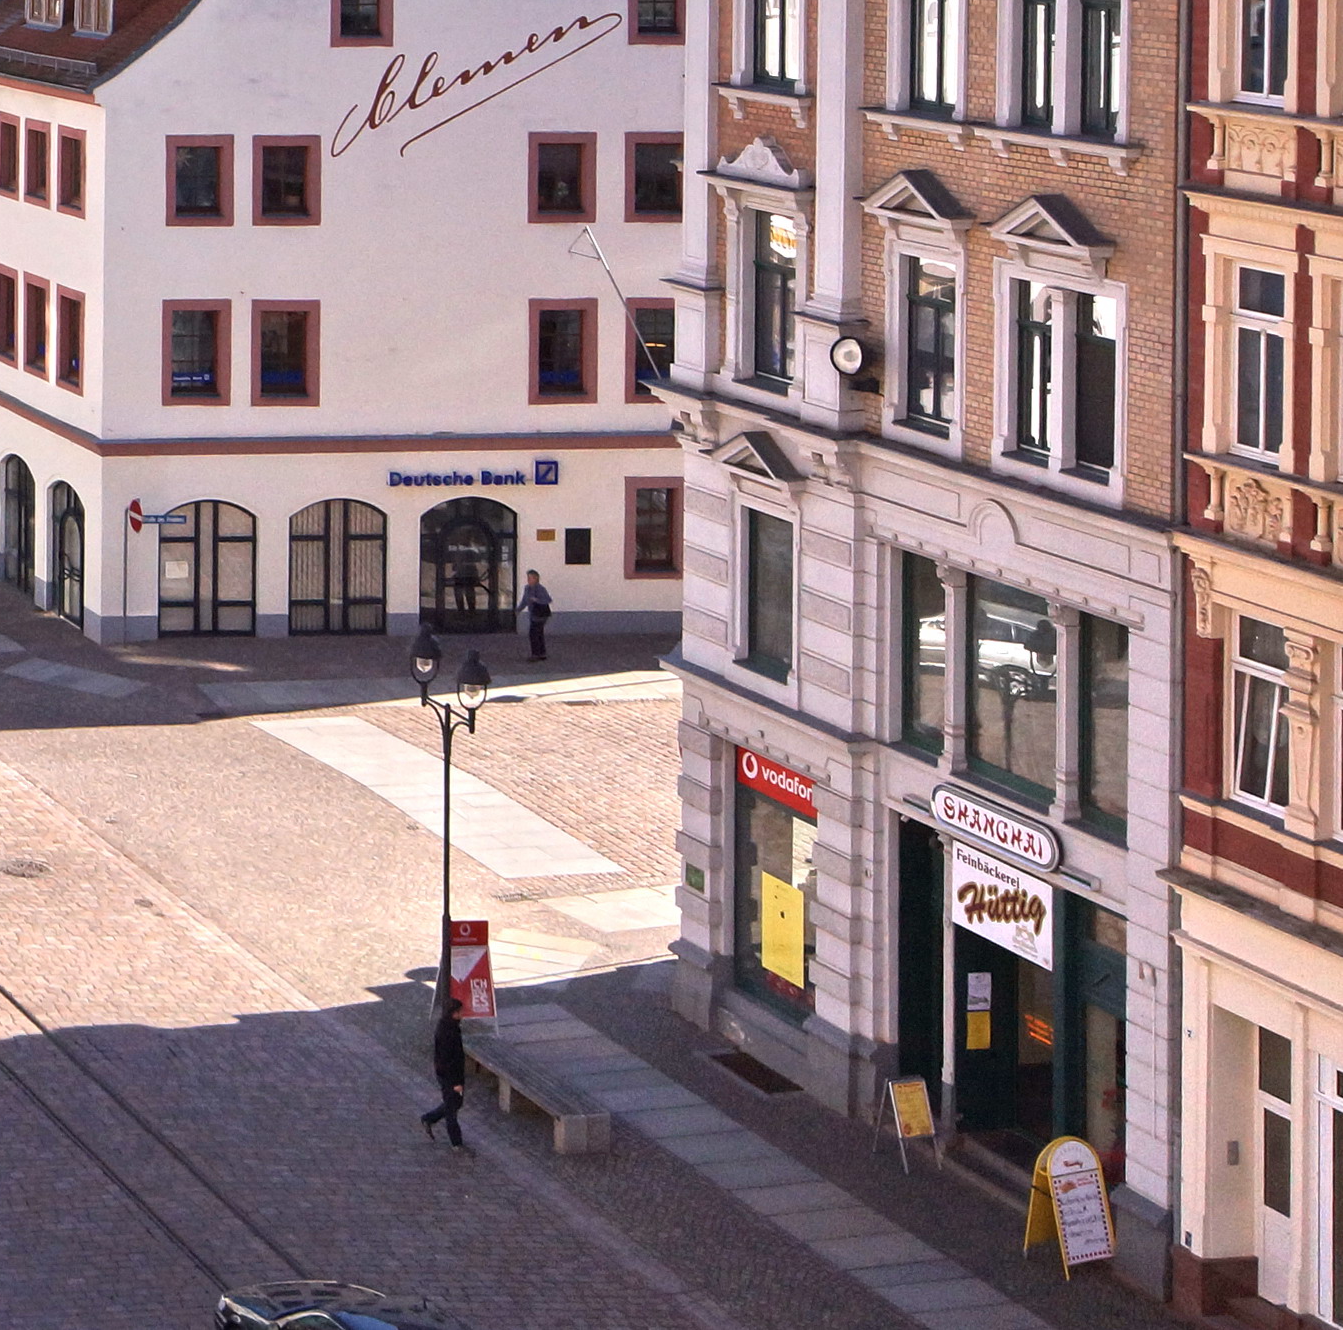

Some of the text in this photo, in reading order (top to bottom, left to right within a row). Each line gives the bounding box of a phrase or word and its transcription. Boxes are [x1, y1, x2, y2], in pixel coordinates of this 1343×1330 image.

[388, 470, 526, 487] Deutsche Bank
[761, 765, 813, 802] vodafon
[943, 796, 1043, 859] SHANGHAI
[956, 848, 1020, 889] Feinbäckerei
[957, 881, 1047, 936] Hüttig
